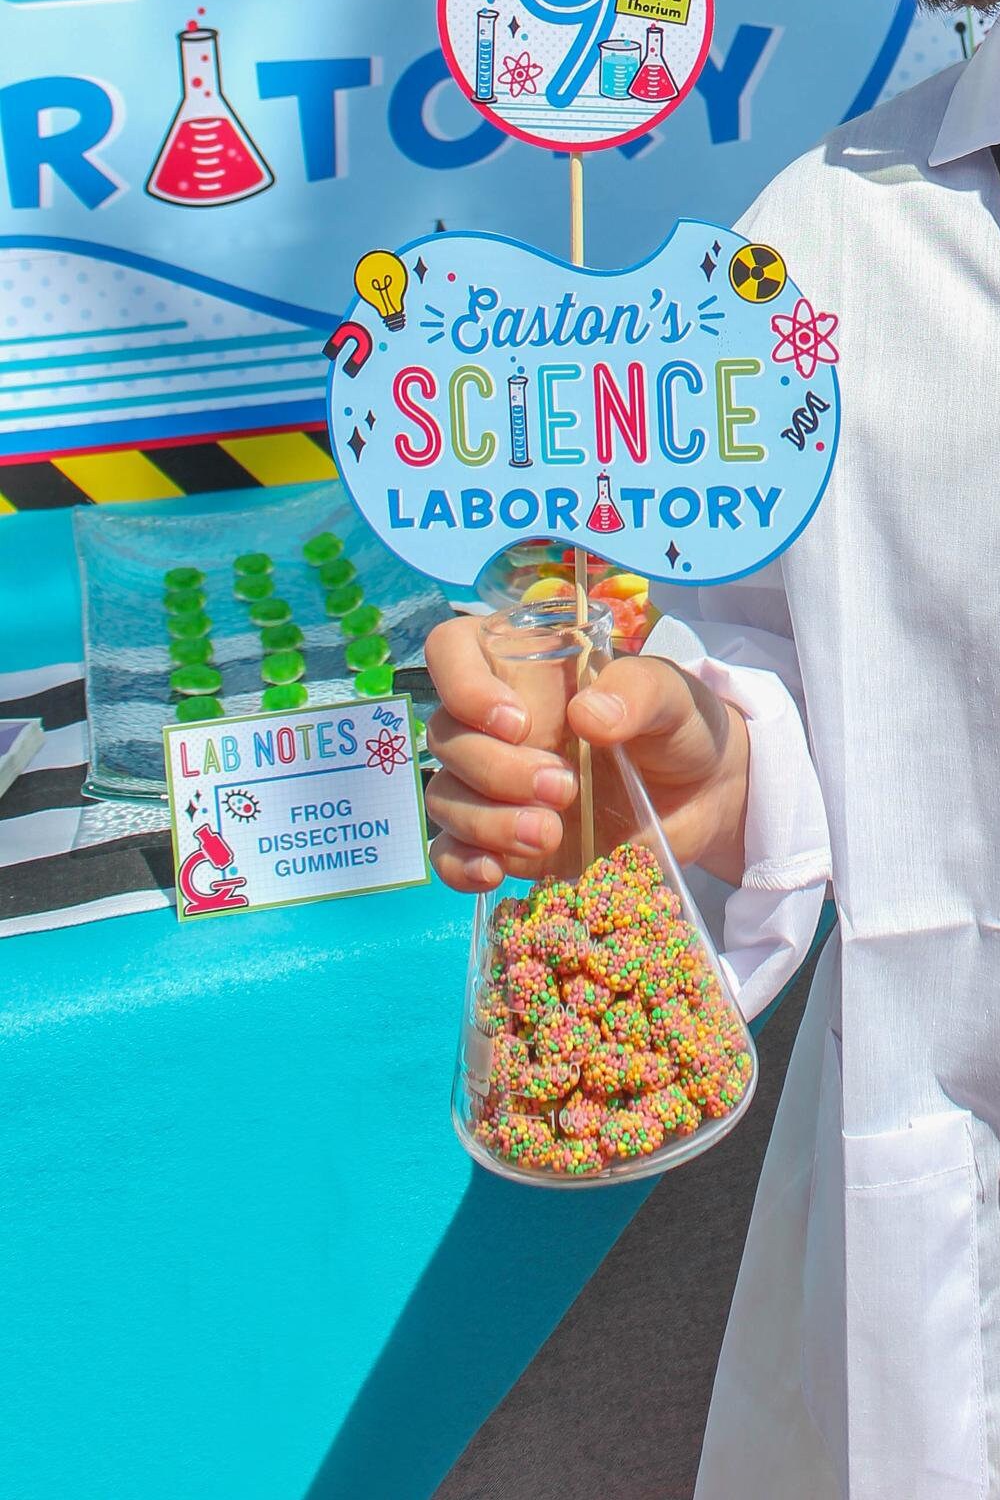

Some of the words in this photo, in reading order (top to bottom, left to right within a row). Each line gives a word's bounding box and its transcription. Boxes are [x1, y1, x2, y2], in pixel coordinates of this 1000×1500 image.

[451, 285, 696, 355] Easton's
[392, 357, 766, 469] SCIENCE
[179, 735, 242, 779] LAB
[253, 718, 359, 768] NOTES
[290, 799, 353, 825] FROG
[257, 818, 390, 854] DISSECTION
[274, 846, 379, 878] GUMMIES
[547, 1108, 585, 1133] 100
